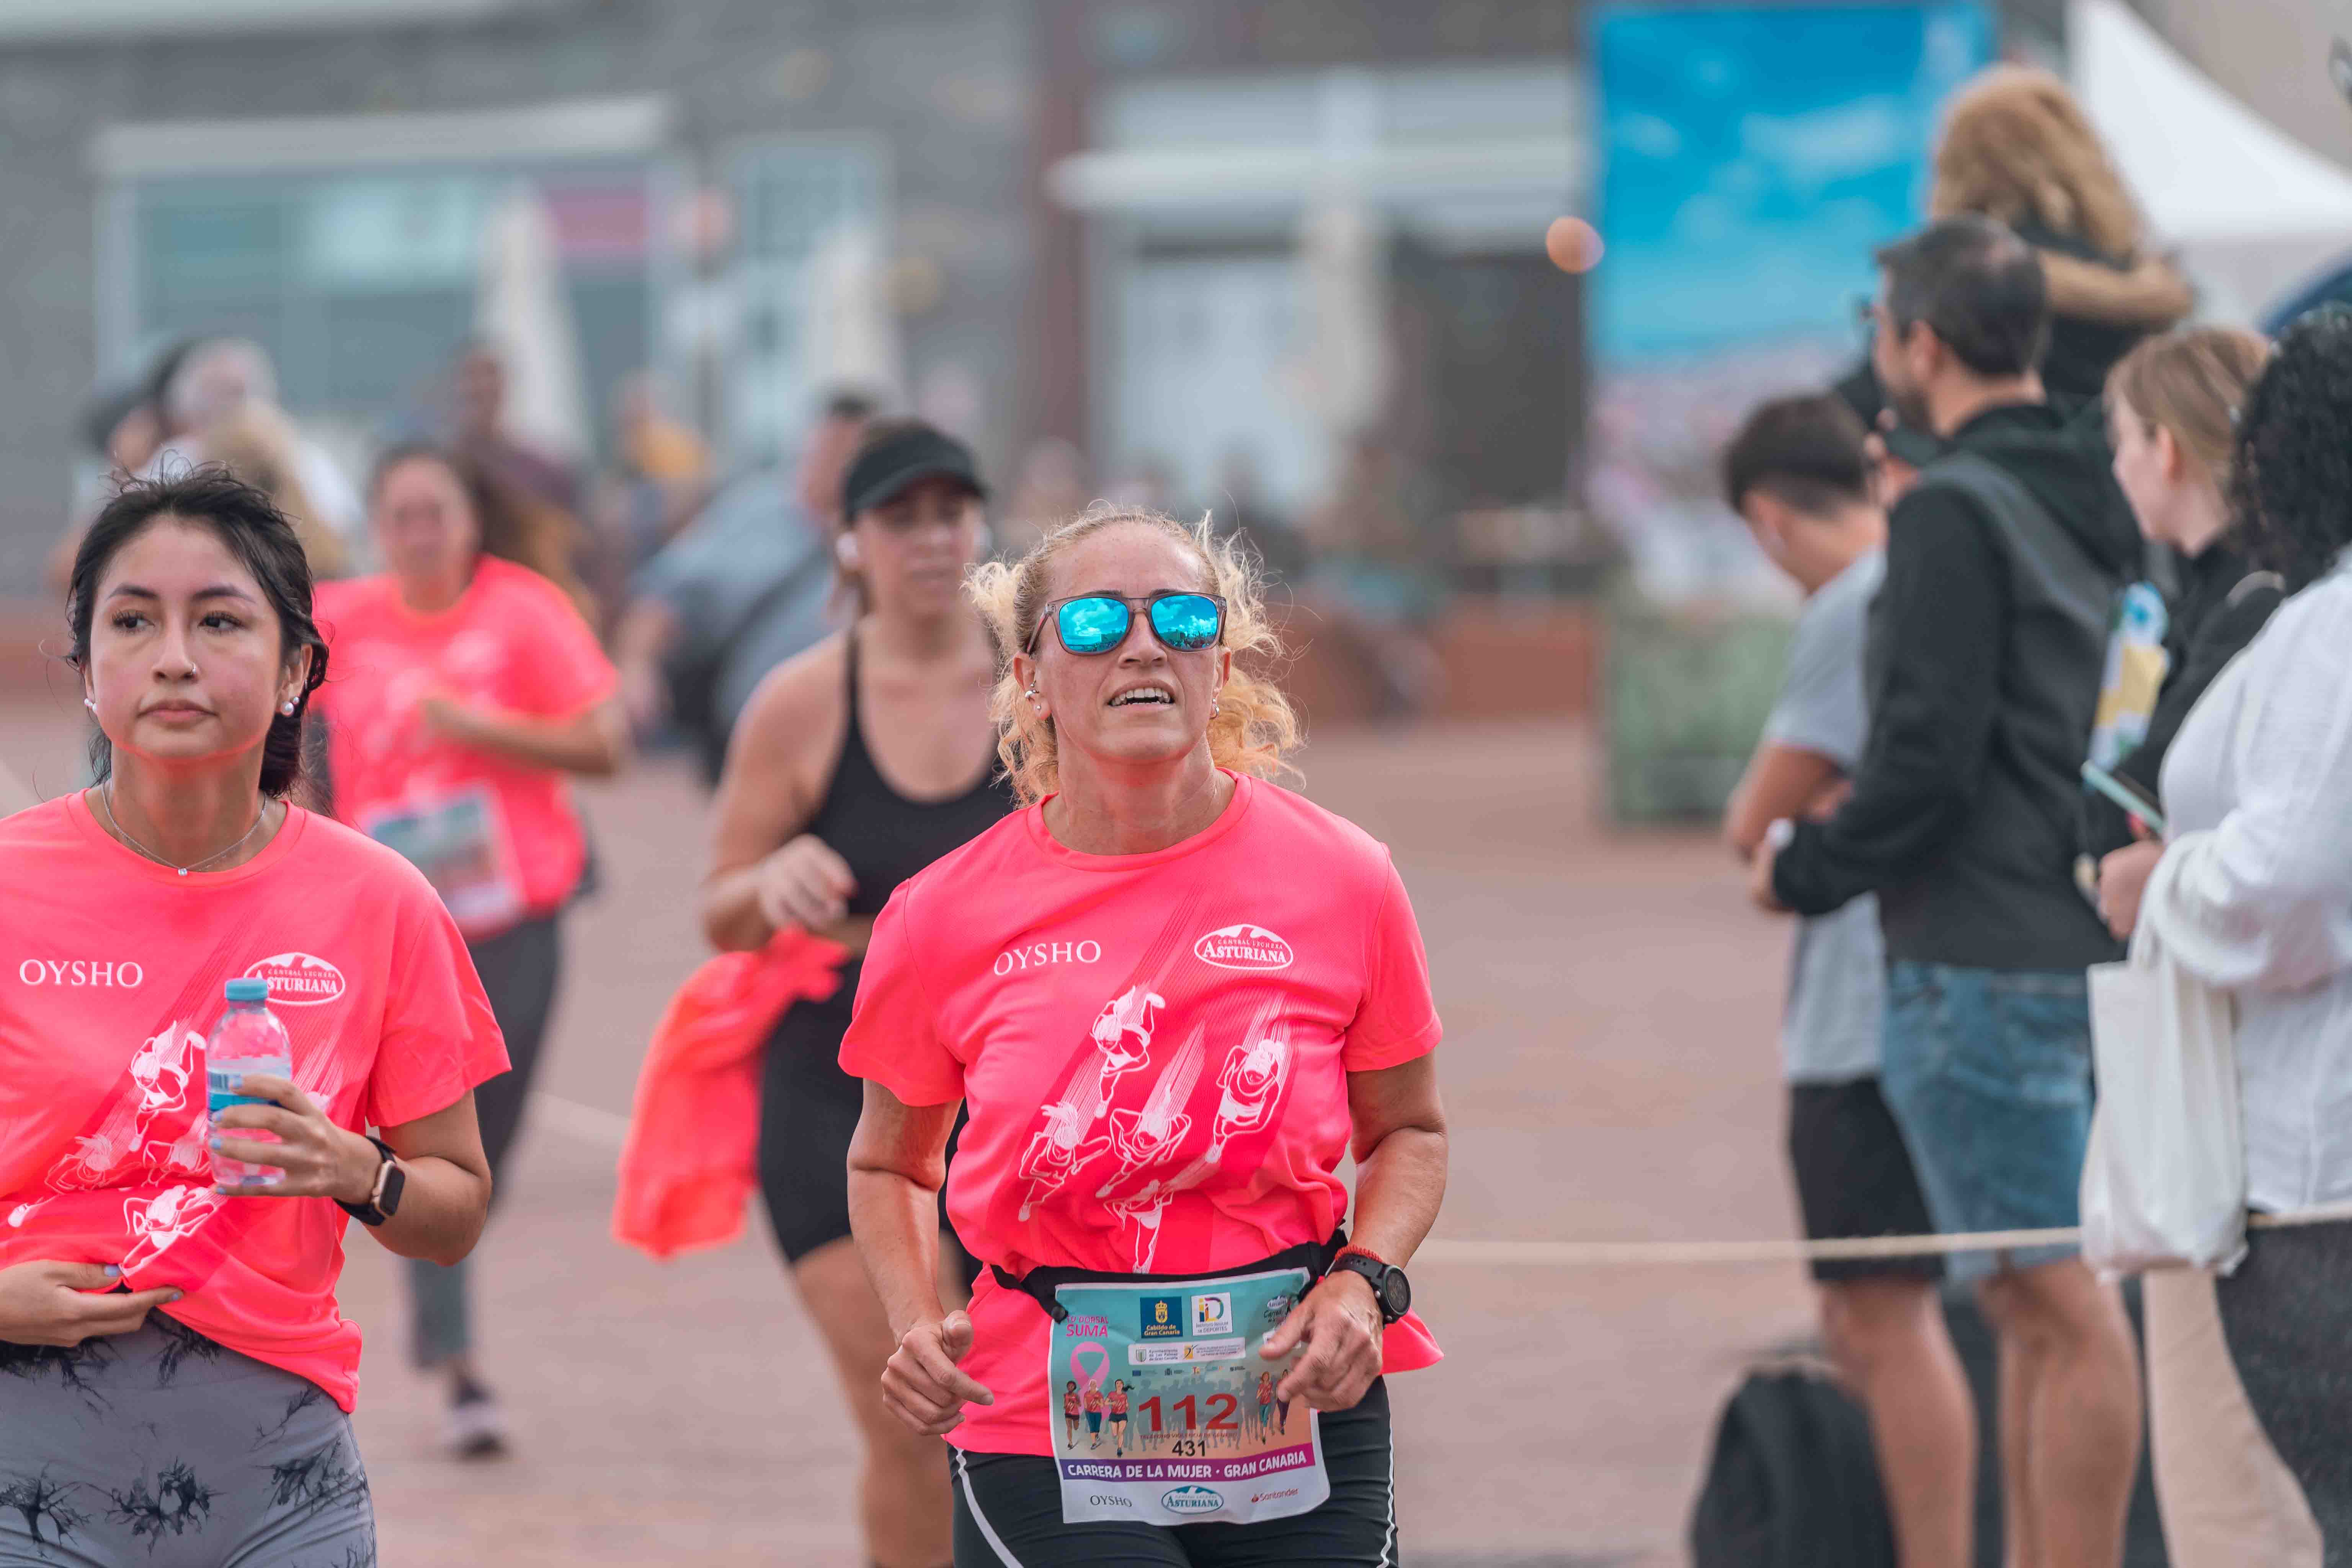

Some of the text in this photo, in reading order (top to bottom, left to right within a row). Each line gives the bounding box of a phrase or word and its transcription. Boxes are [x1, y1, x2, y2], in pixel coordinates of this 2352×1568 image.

[1203, 941, 1287, 963] ASTURIANA
[1253, 941, 1283, 949] LECHERA
[994, 940, 1101, 975] OYSHO
[20, 959, 143, 988] OYSHO
[1066, 1323, 1109, 1337] SUMA
[1139, 1393, 1238, 1431] 112
[1172, 1440, 1205, 1457] 431
[1067, 1450, 1307, 1478] CARRERA DE LA MUJER GRAN CANARIA
[1090, 1495, 1132, 1507] OYSHO
[1167, 1496, 1218, 1507] ASTURIANA
[1259, 1488, 1299, 1501] Santander
